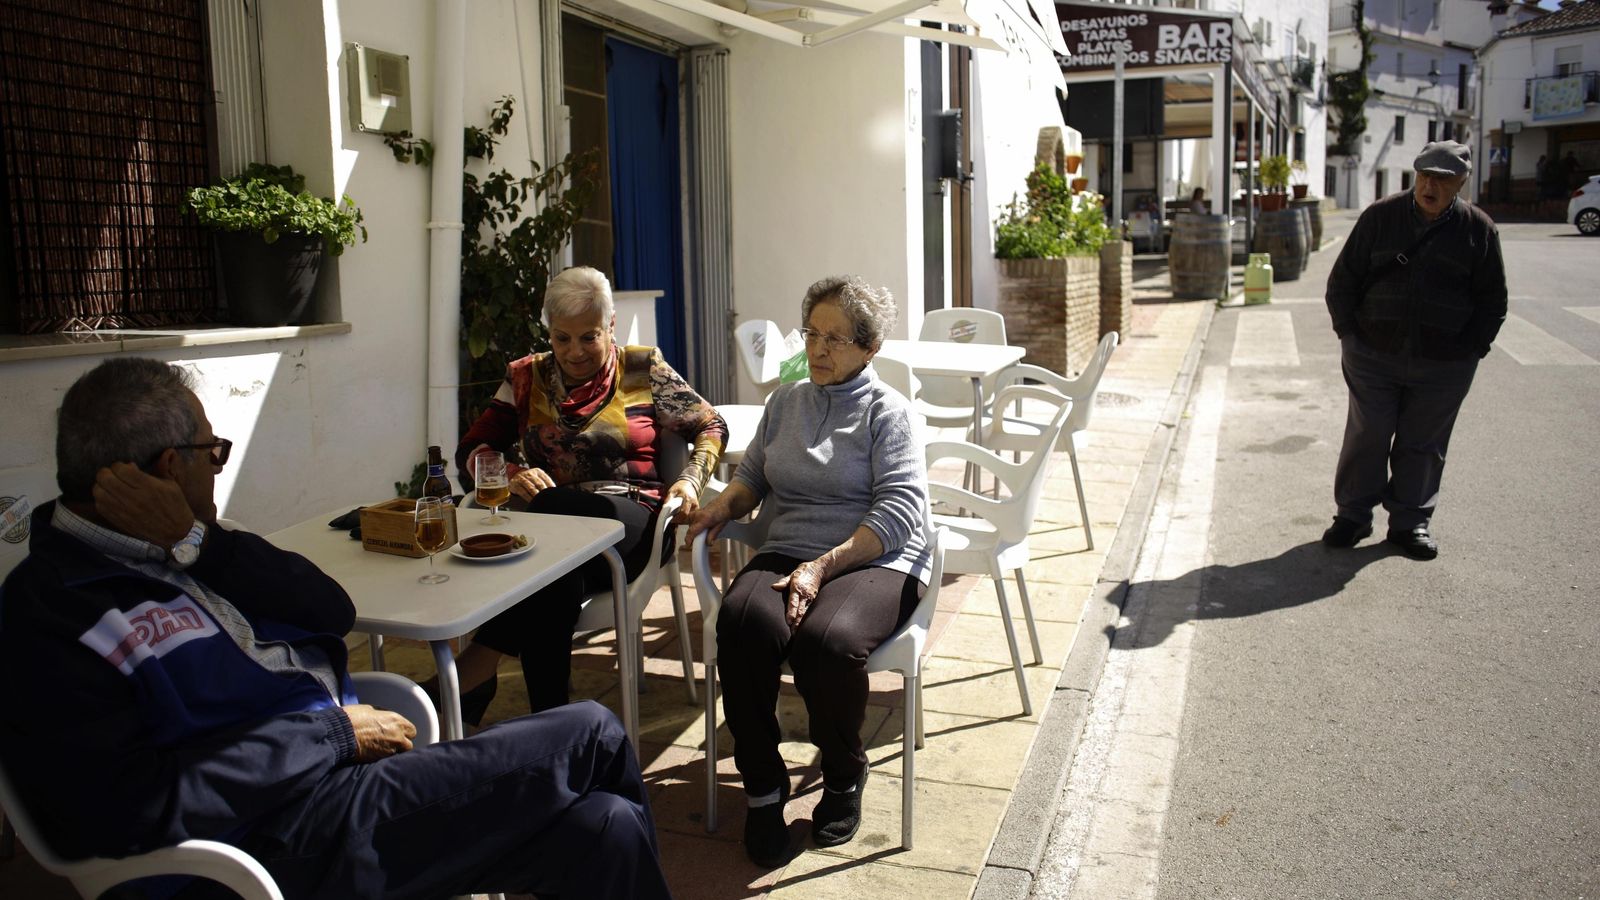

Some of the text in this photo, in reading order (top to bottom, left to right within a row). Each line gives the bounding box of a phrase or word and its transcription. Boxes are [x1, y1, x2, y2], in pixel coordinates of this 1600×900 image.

[1061, 14, 1148, 32] DESAYUNOS
[1081, 28, 1127, 42] TAPAS
[1158, 22, 1232, 49] BAR
[1077, 39, 1133, 54] PLATOS
[1155, 48, 1231, 65] SNACKS
